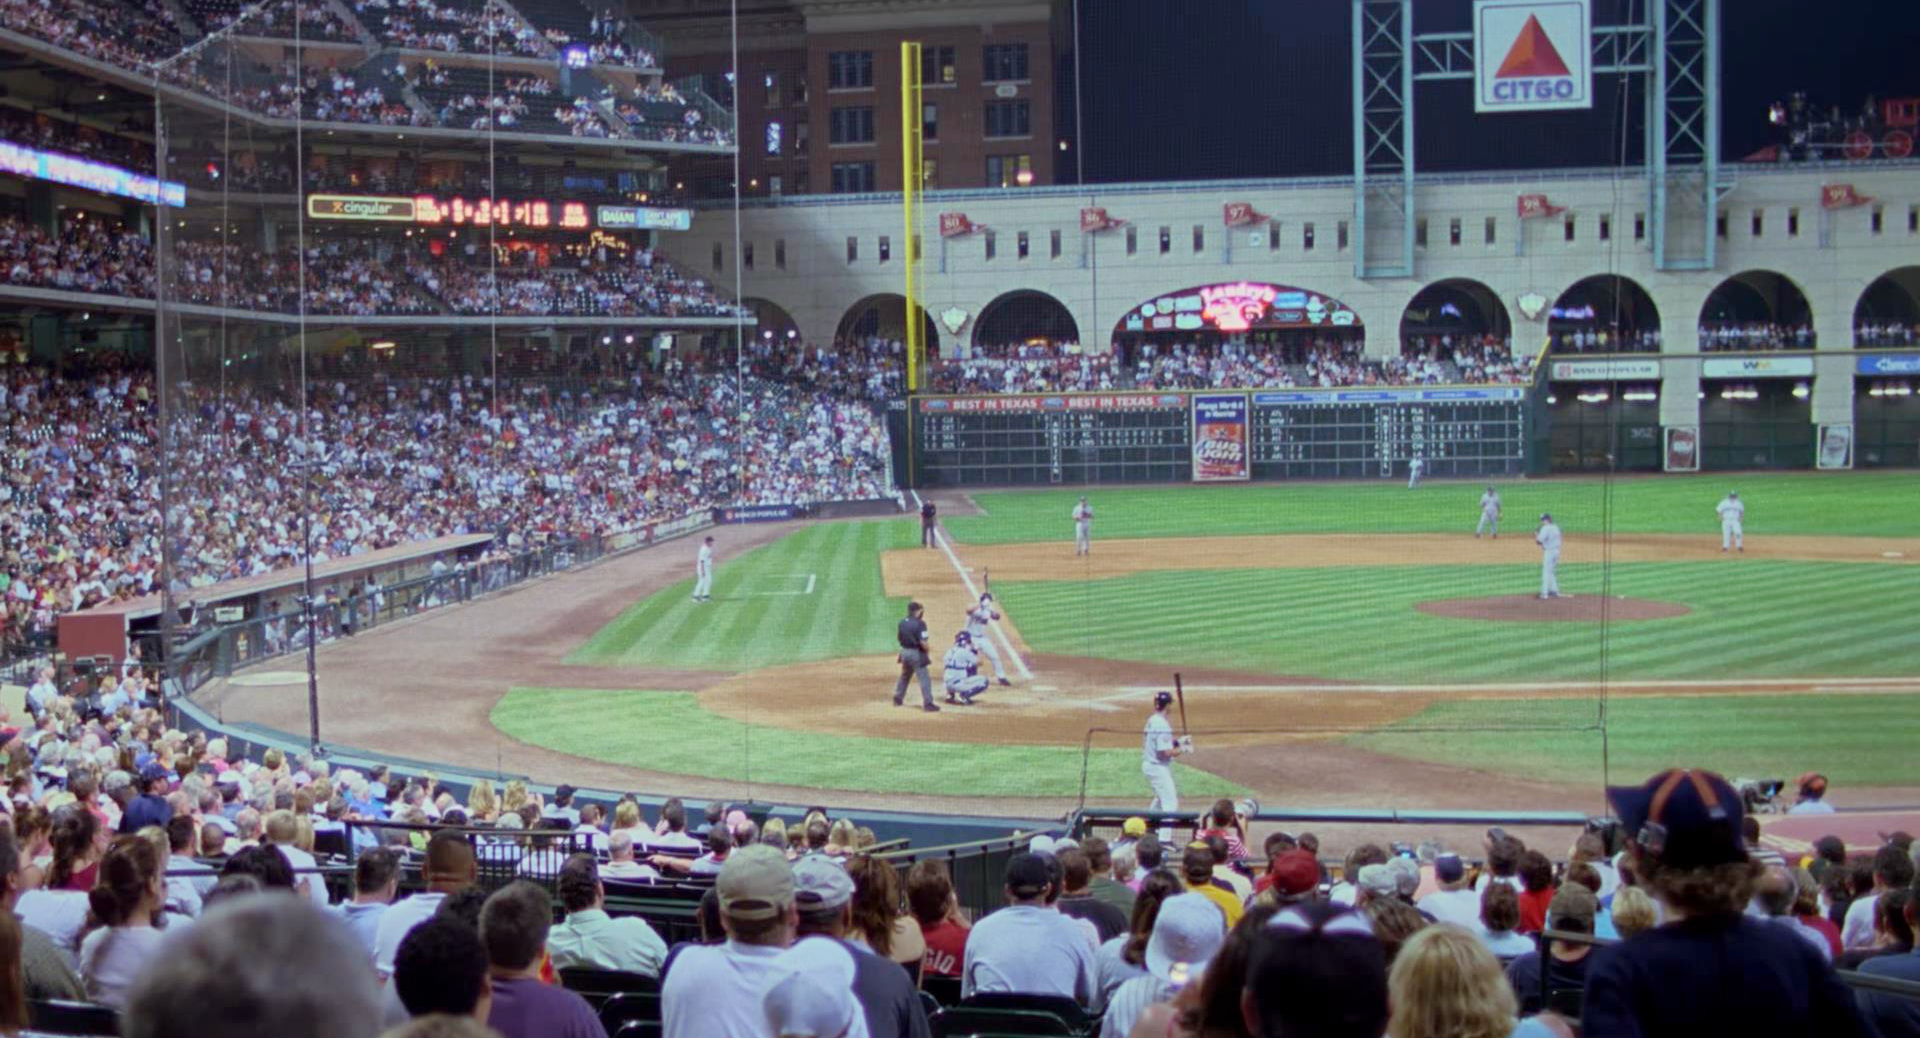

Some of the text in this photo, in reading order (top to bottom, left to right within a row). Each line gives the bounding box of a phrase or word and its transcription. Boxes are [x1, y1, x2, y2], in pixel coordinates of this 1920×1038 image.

[1493, 79, 1574, 99] CITGO
[343, 202, 392, 218] cingular
[1230, 206, 1246, 220] 97
[953, 400, 981, 410] BEST
[983, 399, 998, 410] IN
[1000, 398, 1038, 409] TEXAS
[1068, 398, 1097, 409] BEST
[1100, 398, 1113, 408] IN
[1115, 396, 1154, 407] TEXAS
[1052, 420, 1060, 474] AMERICAN
[1203, 440, 1241, 452] BUD
[1382, 414, 1390, 470] NATIONAL
[1199, 447, 1243, 461] LIGHT
[734, 508, 788, 519] BANCO POPULAR
